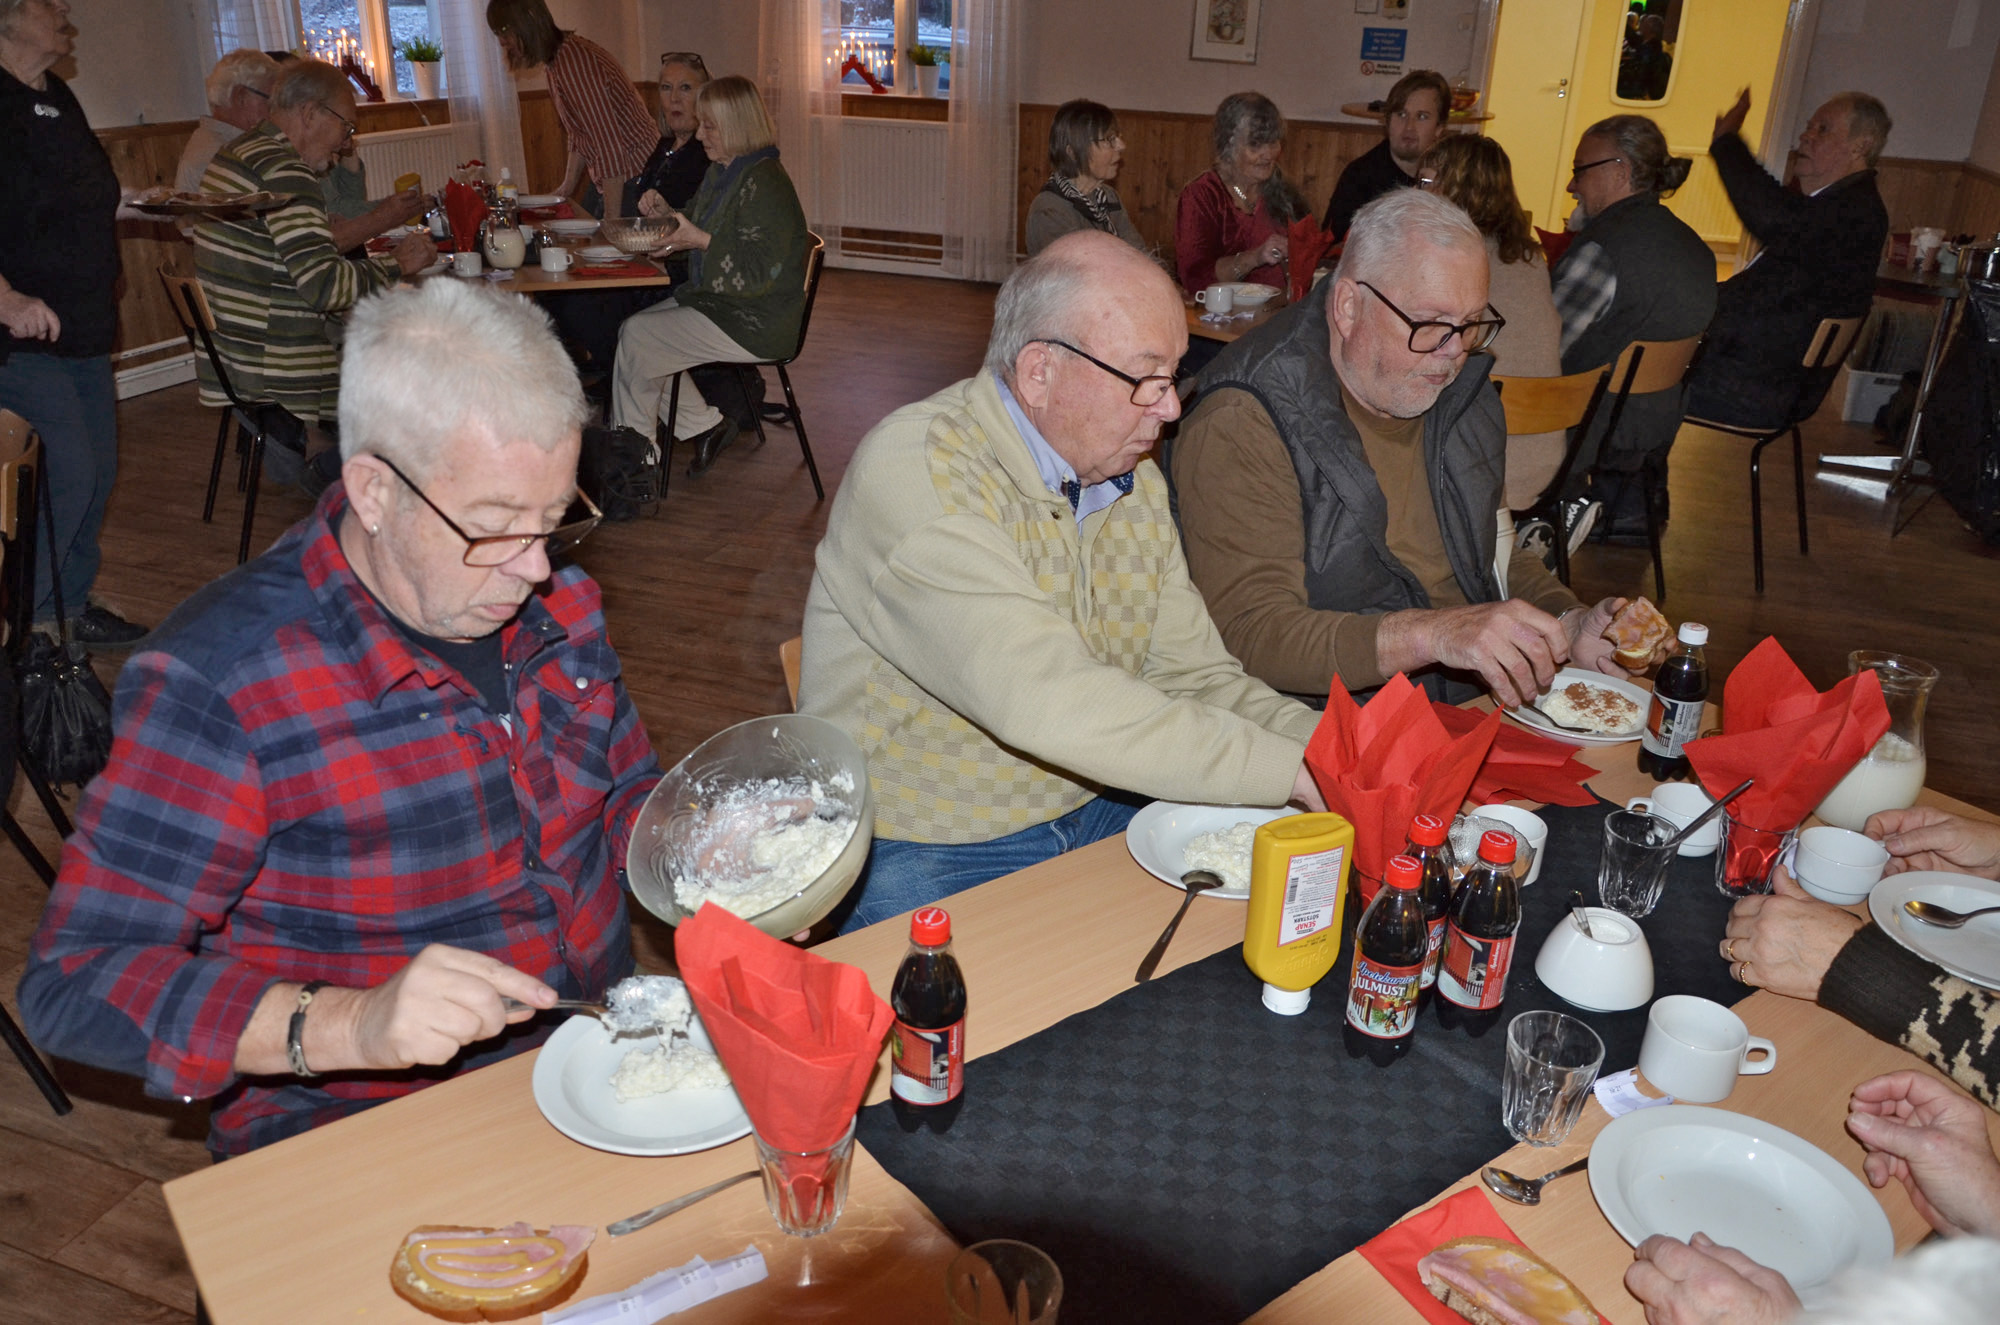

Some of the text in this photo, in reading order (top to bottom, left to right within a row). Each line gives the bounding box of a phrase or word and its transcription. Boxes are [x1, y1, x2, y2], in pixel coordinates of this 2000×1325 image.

[1295, 920, 1317, 931] SENAP
[1352, 971, 1406, 997] JULMUST
[1356, 960, 1417, 985] Apotekarnes
